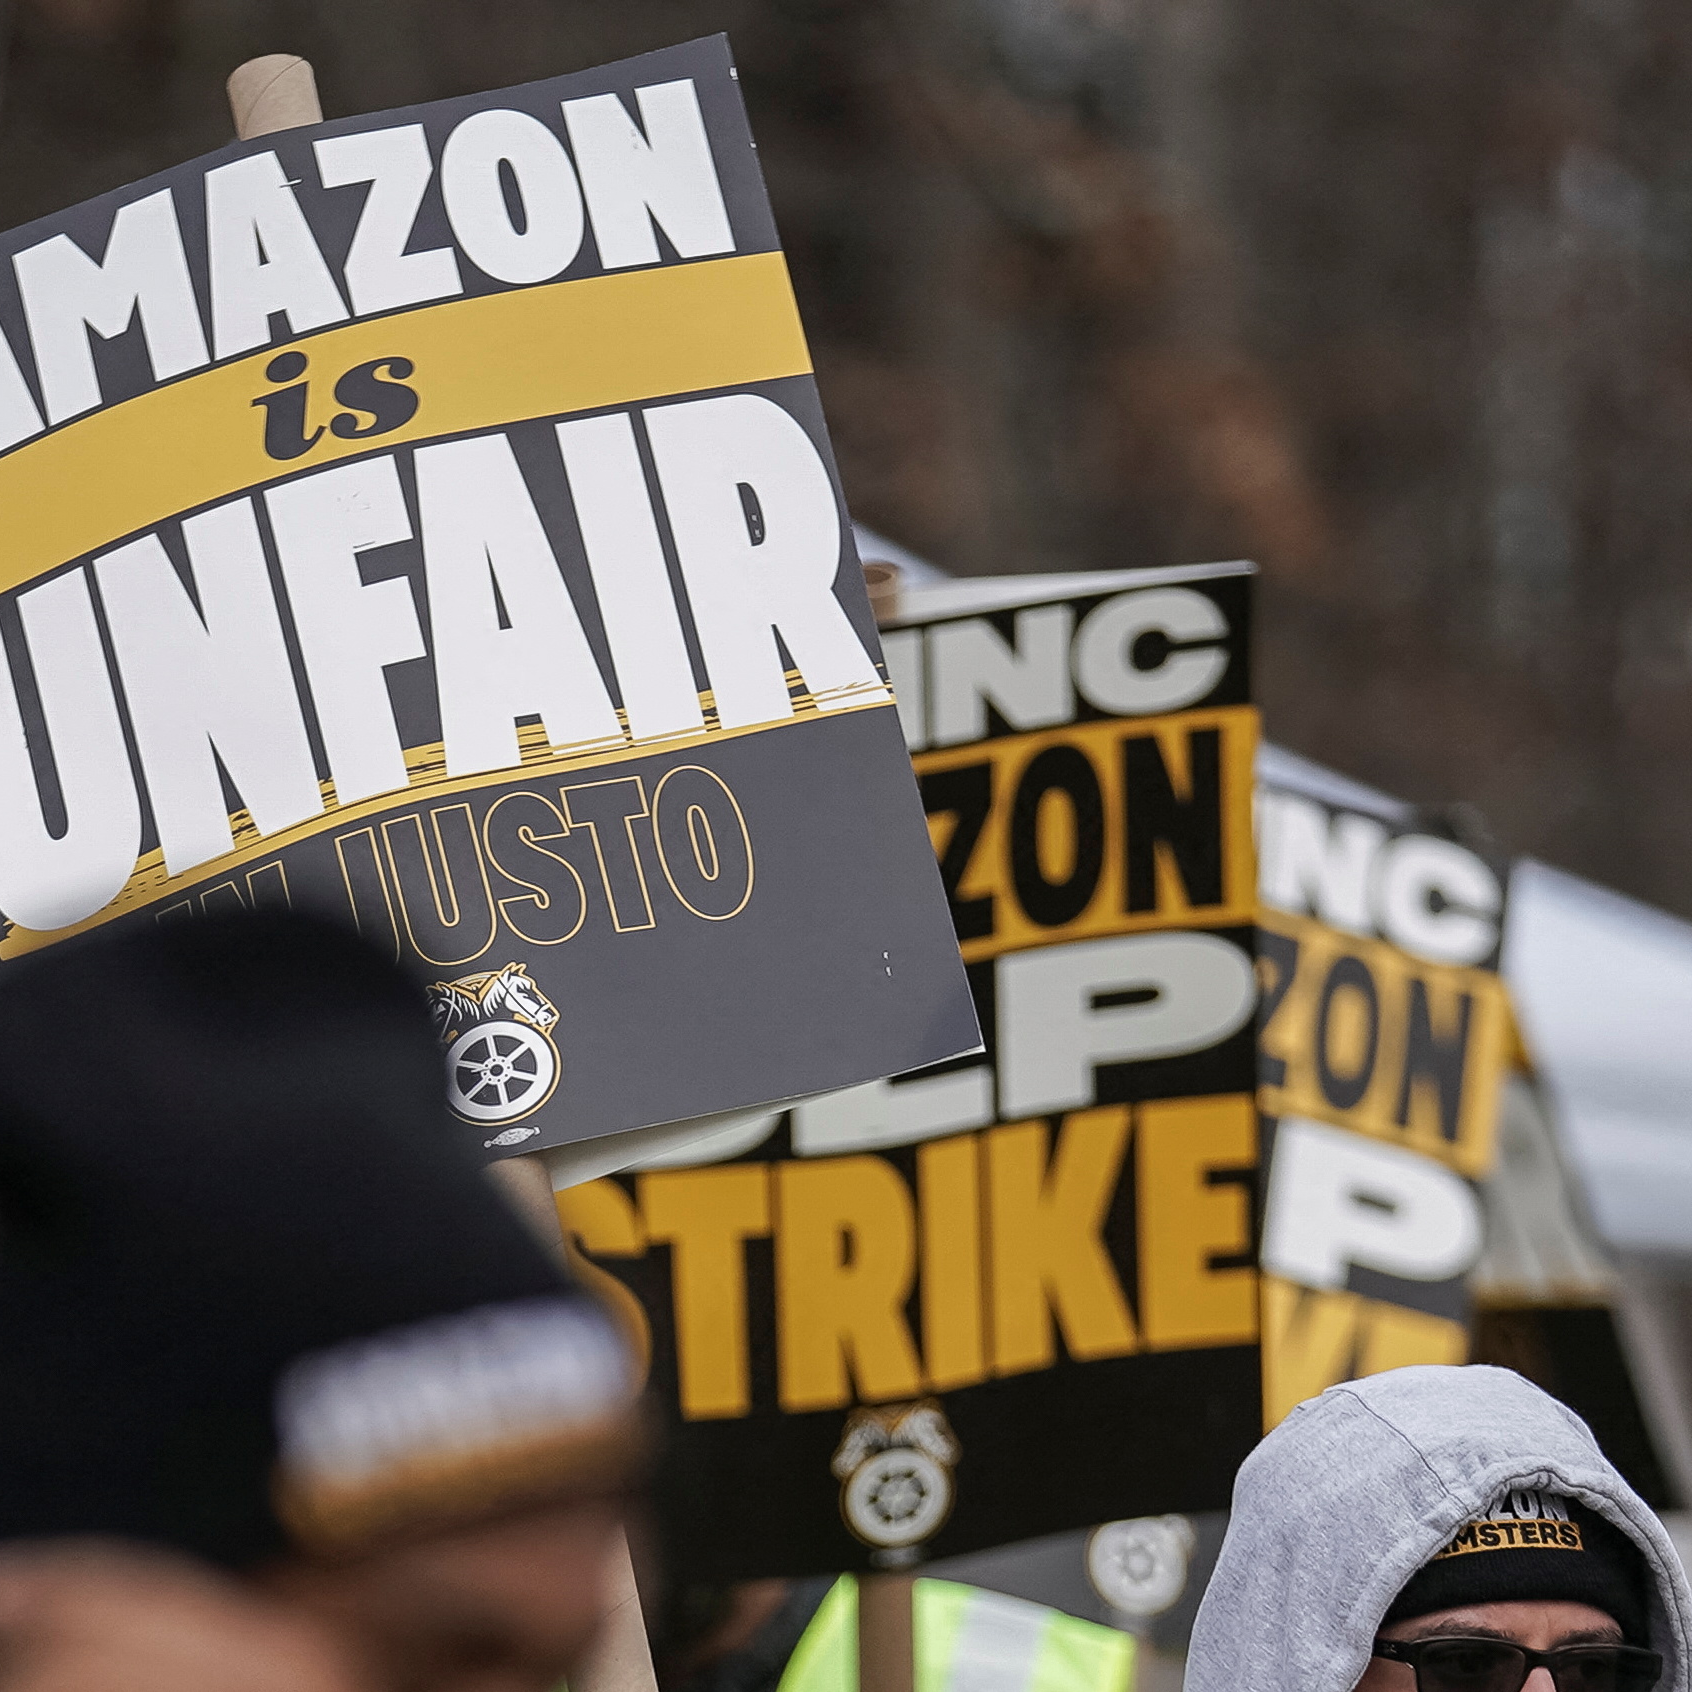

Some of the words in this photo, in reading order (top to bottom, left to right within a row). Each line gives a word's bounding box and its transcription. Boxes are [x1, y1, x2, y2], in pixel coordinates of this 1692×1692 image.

[250, 351, 421, 462] is
[155, 765, 754, 966] JUSTO
[1442, 1521, 1580, 1554] MSTERS
